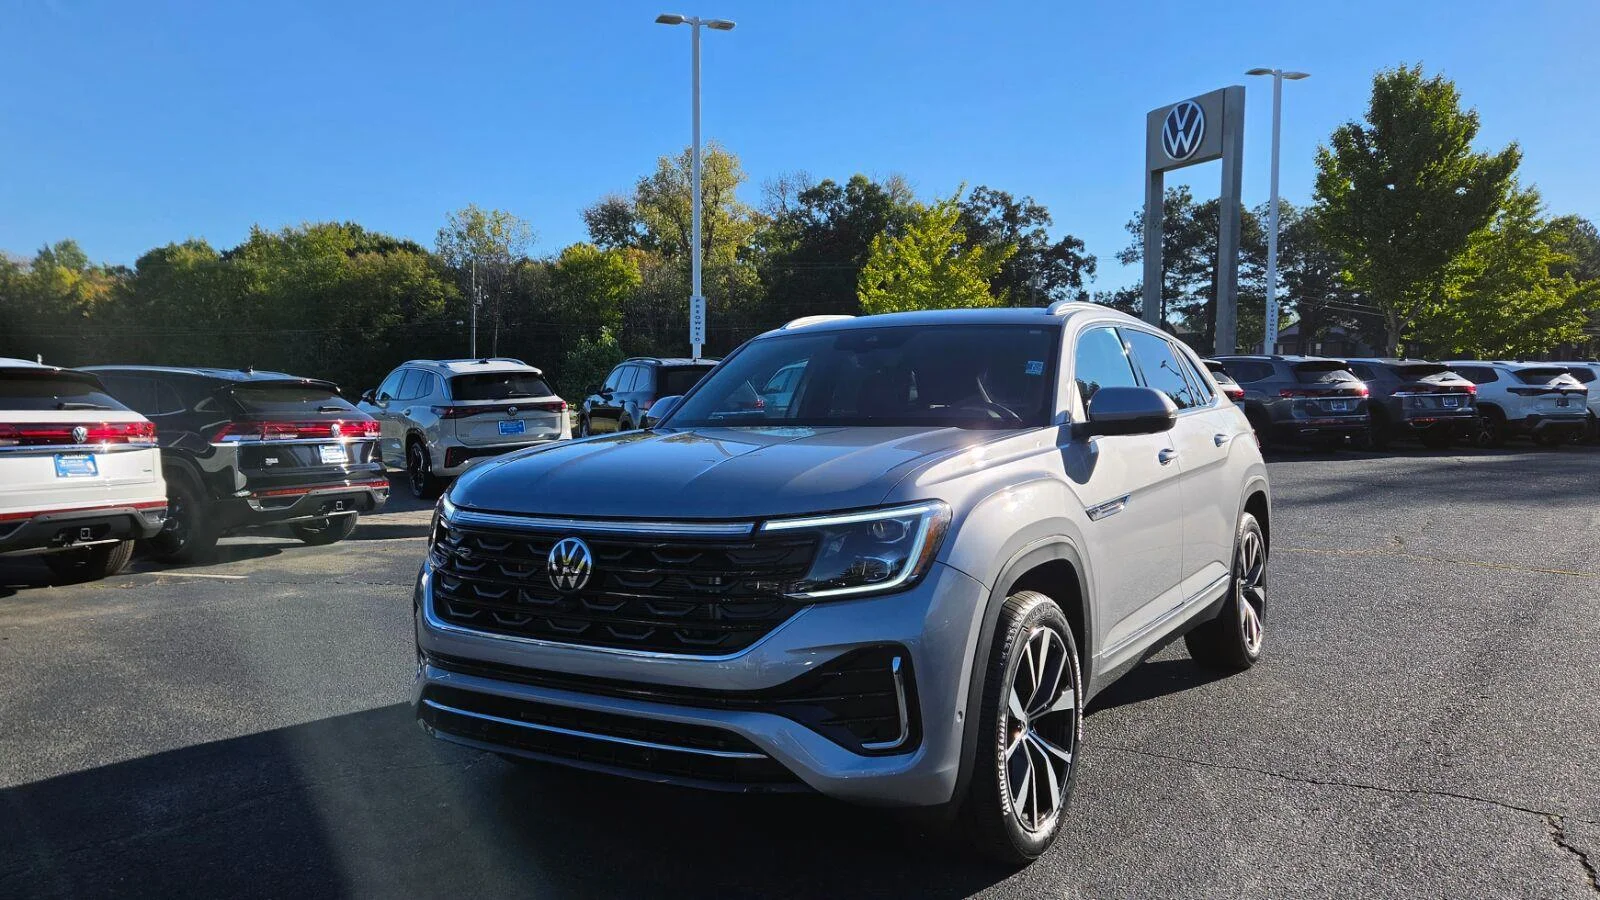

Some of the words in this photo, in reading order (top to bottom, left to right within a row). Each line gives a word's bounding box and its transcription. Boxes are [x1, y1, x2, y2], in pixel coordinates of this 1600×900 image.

[1163, 101, 1203, 159] VW
[548, 538, 592, 591] VW
[997, 713, 1012, 817] BRIDGESTONE
